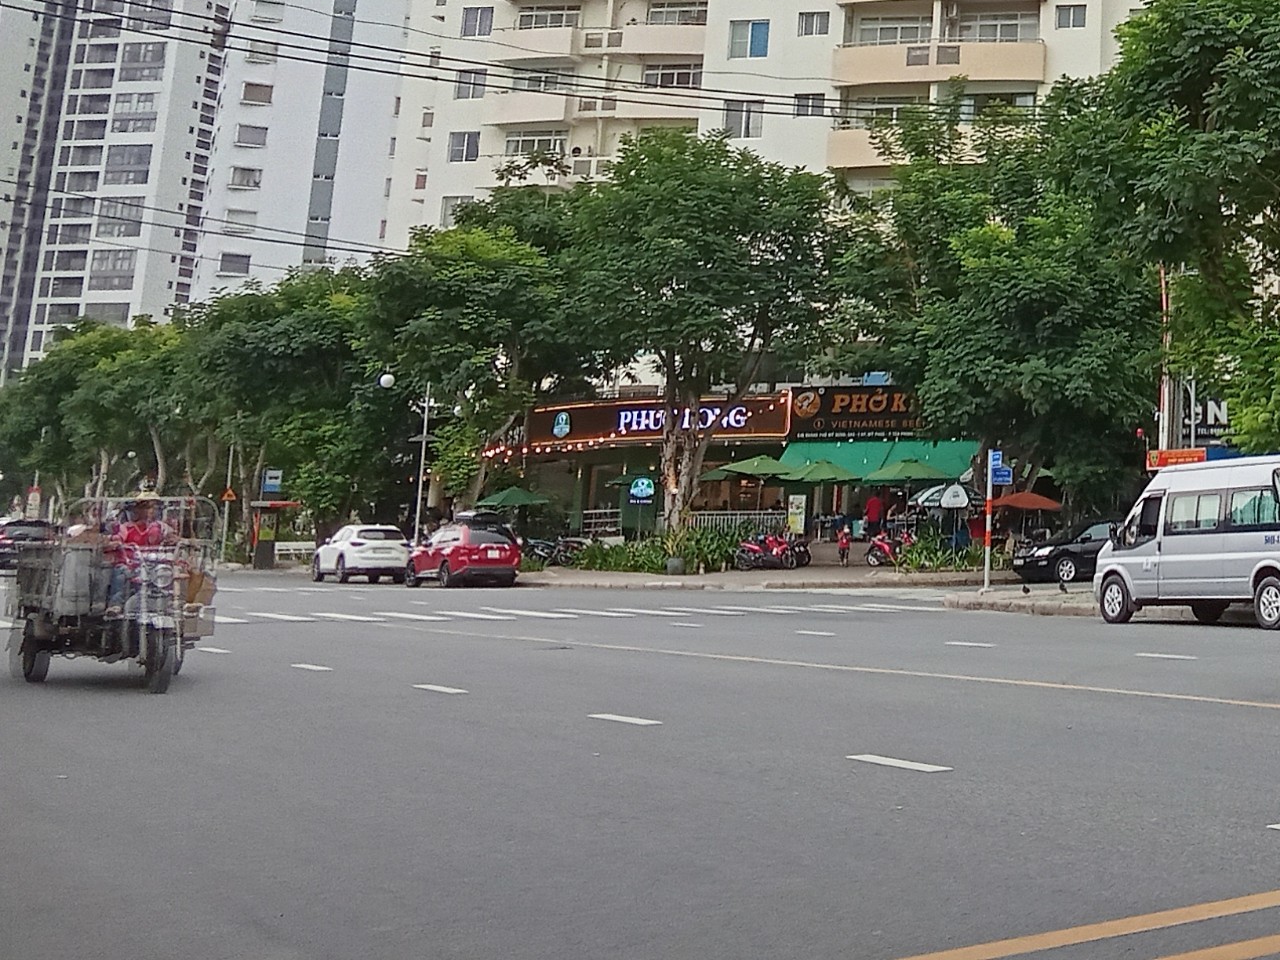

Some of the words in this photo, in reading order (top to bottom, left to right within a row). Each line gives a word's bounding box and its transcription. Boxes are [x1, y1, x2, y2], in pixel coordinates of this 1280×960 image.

[831, 388, 888, 413] PHỞ
[831, 419, 897, 430] VIETNAMESE
[902, 418, 926, 429] BEE
